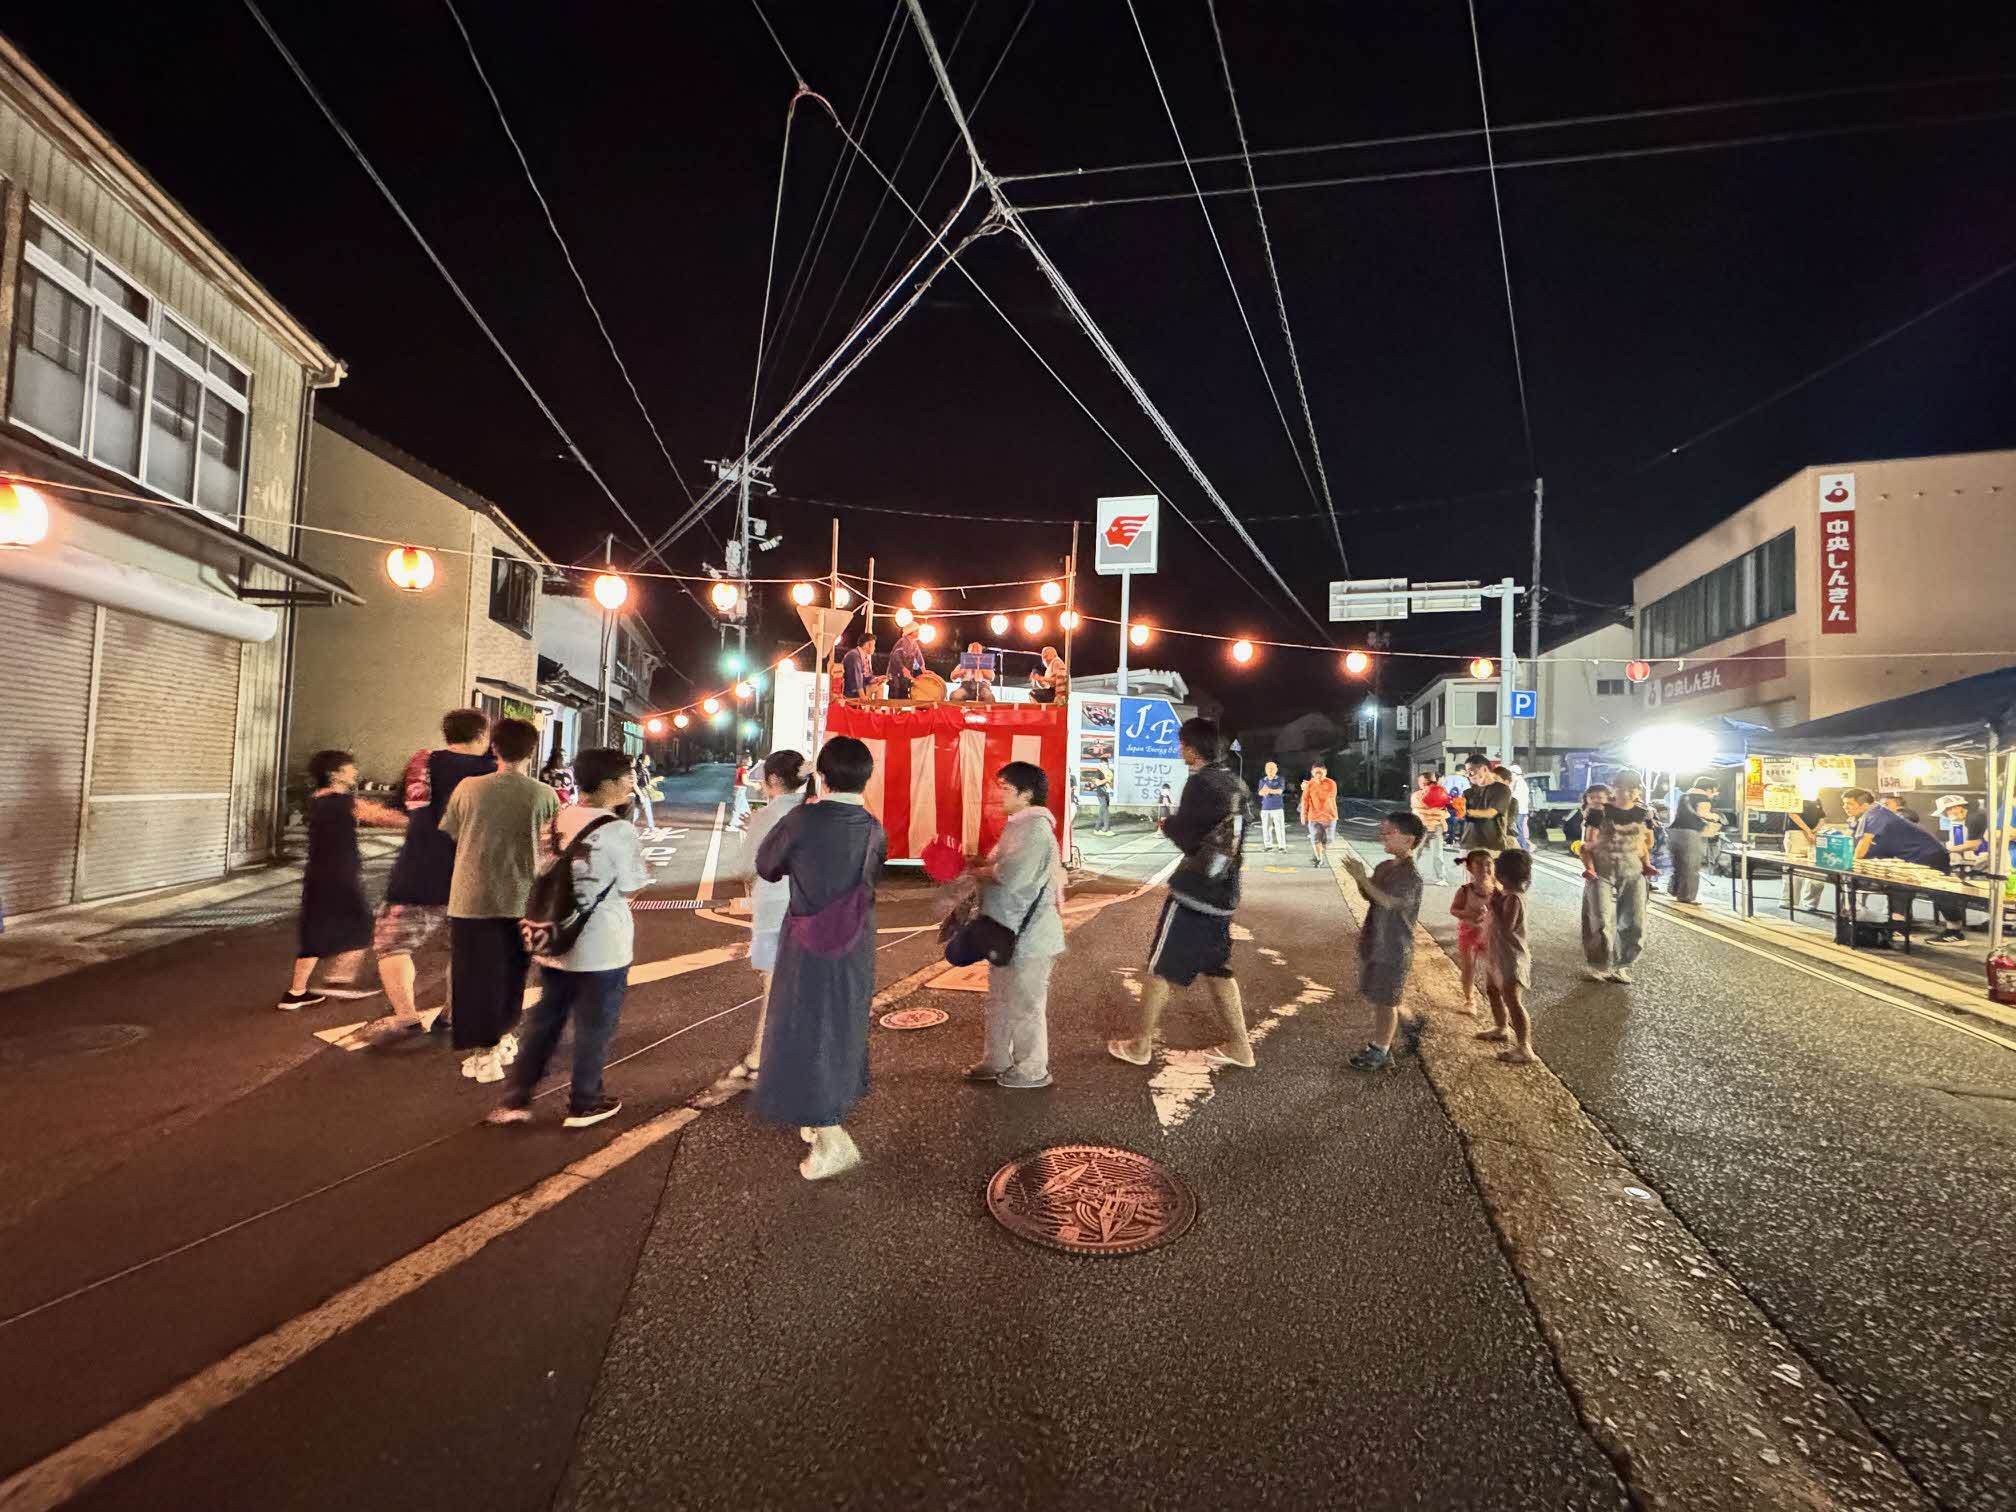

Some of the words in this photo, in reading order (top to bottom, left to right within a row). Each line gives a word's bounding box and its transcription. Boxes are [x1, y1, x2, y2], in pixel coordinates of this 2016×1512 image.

[1826, 519, 1850, 621] 中央しんきん
[1664, 667, 1721, 698] 中央しんきん
[1515, 693, 1531, 715] P
[1126, 744, 1144, 753] Japan
[1145, 745, 1167, 756] Energy
[1134, 763, 1172, 775] ジャパン
